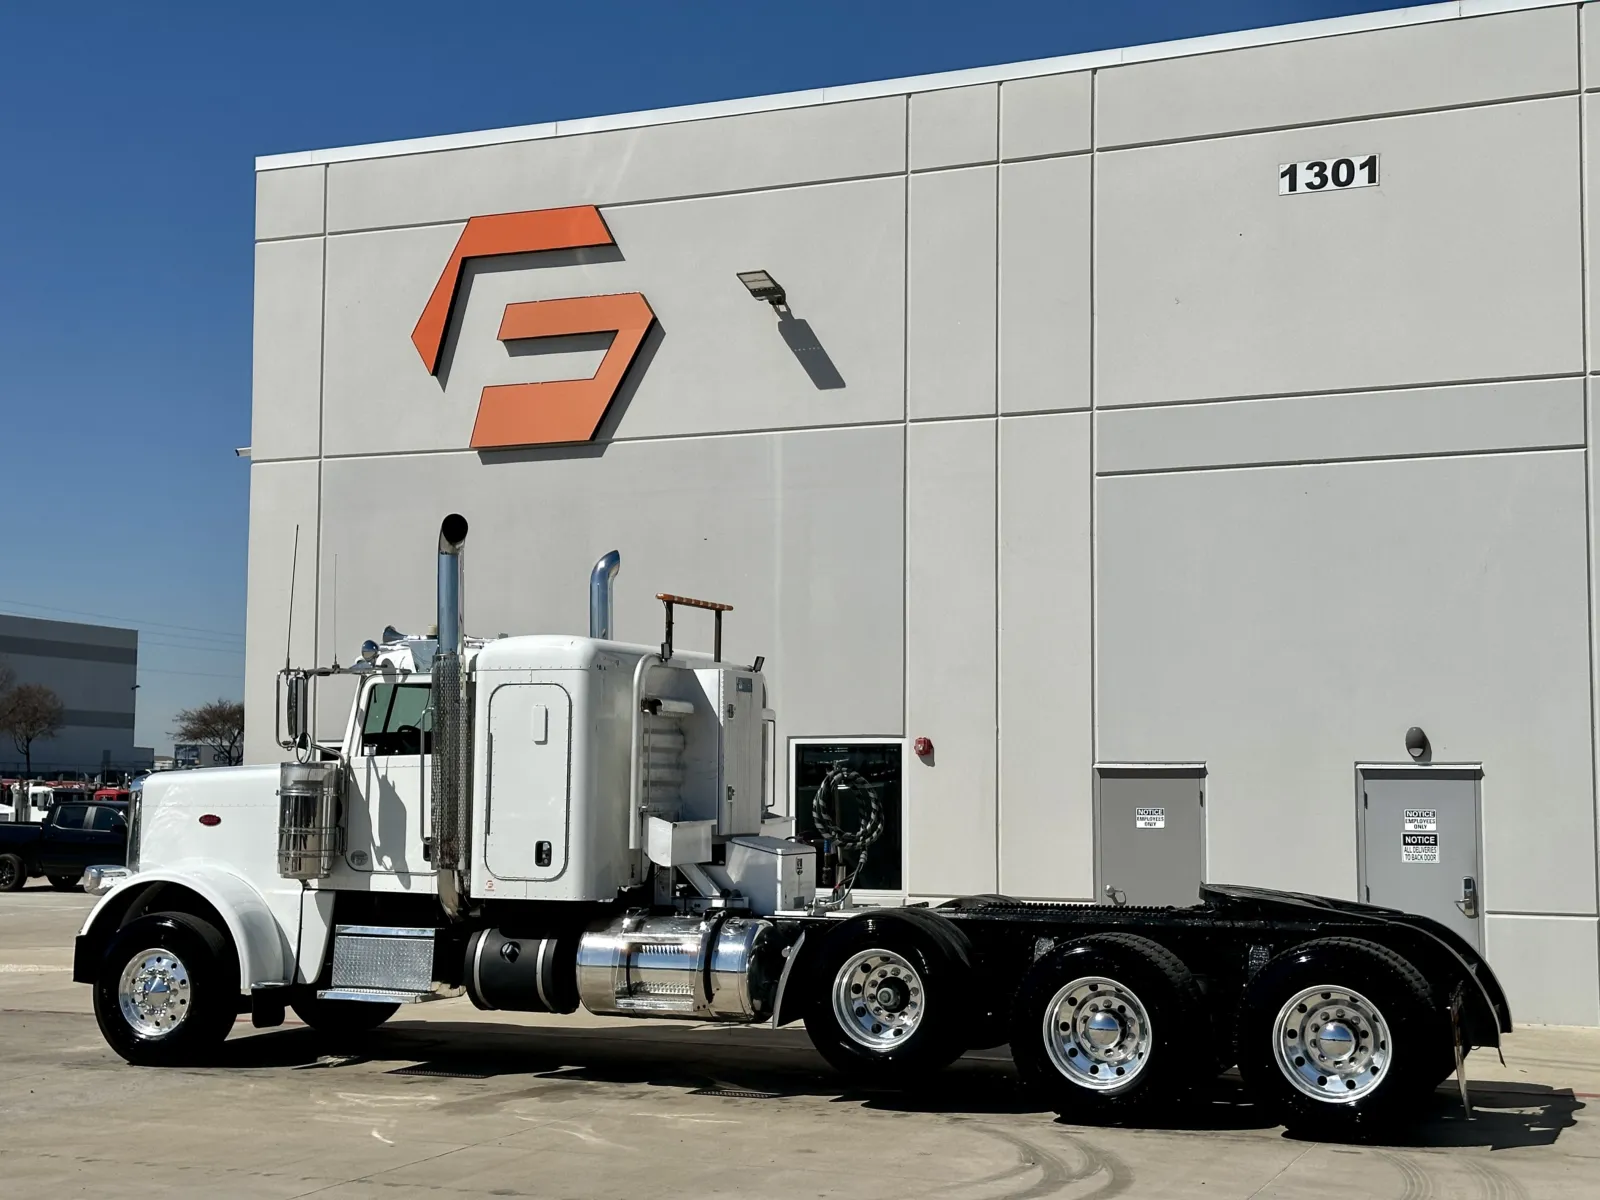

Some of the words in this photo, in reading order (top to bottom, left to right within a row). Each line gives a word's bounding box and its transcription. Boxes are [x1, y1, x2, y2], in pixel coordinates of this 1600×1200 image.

[1280, 154, 1377, 192] 1301
[1405, 836, 1436, 844] NOTICE
[1404, 846, 1413, 854] ALL
[1413, 846, 1437, 854] DELIVERIES
[1404, 853, 1411, 861] TO
[1412, 853, 1424, 861] BACK
[1424, 853, 1437, 861] DOOR
